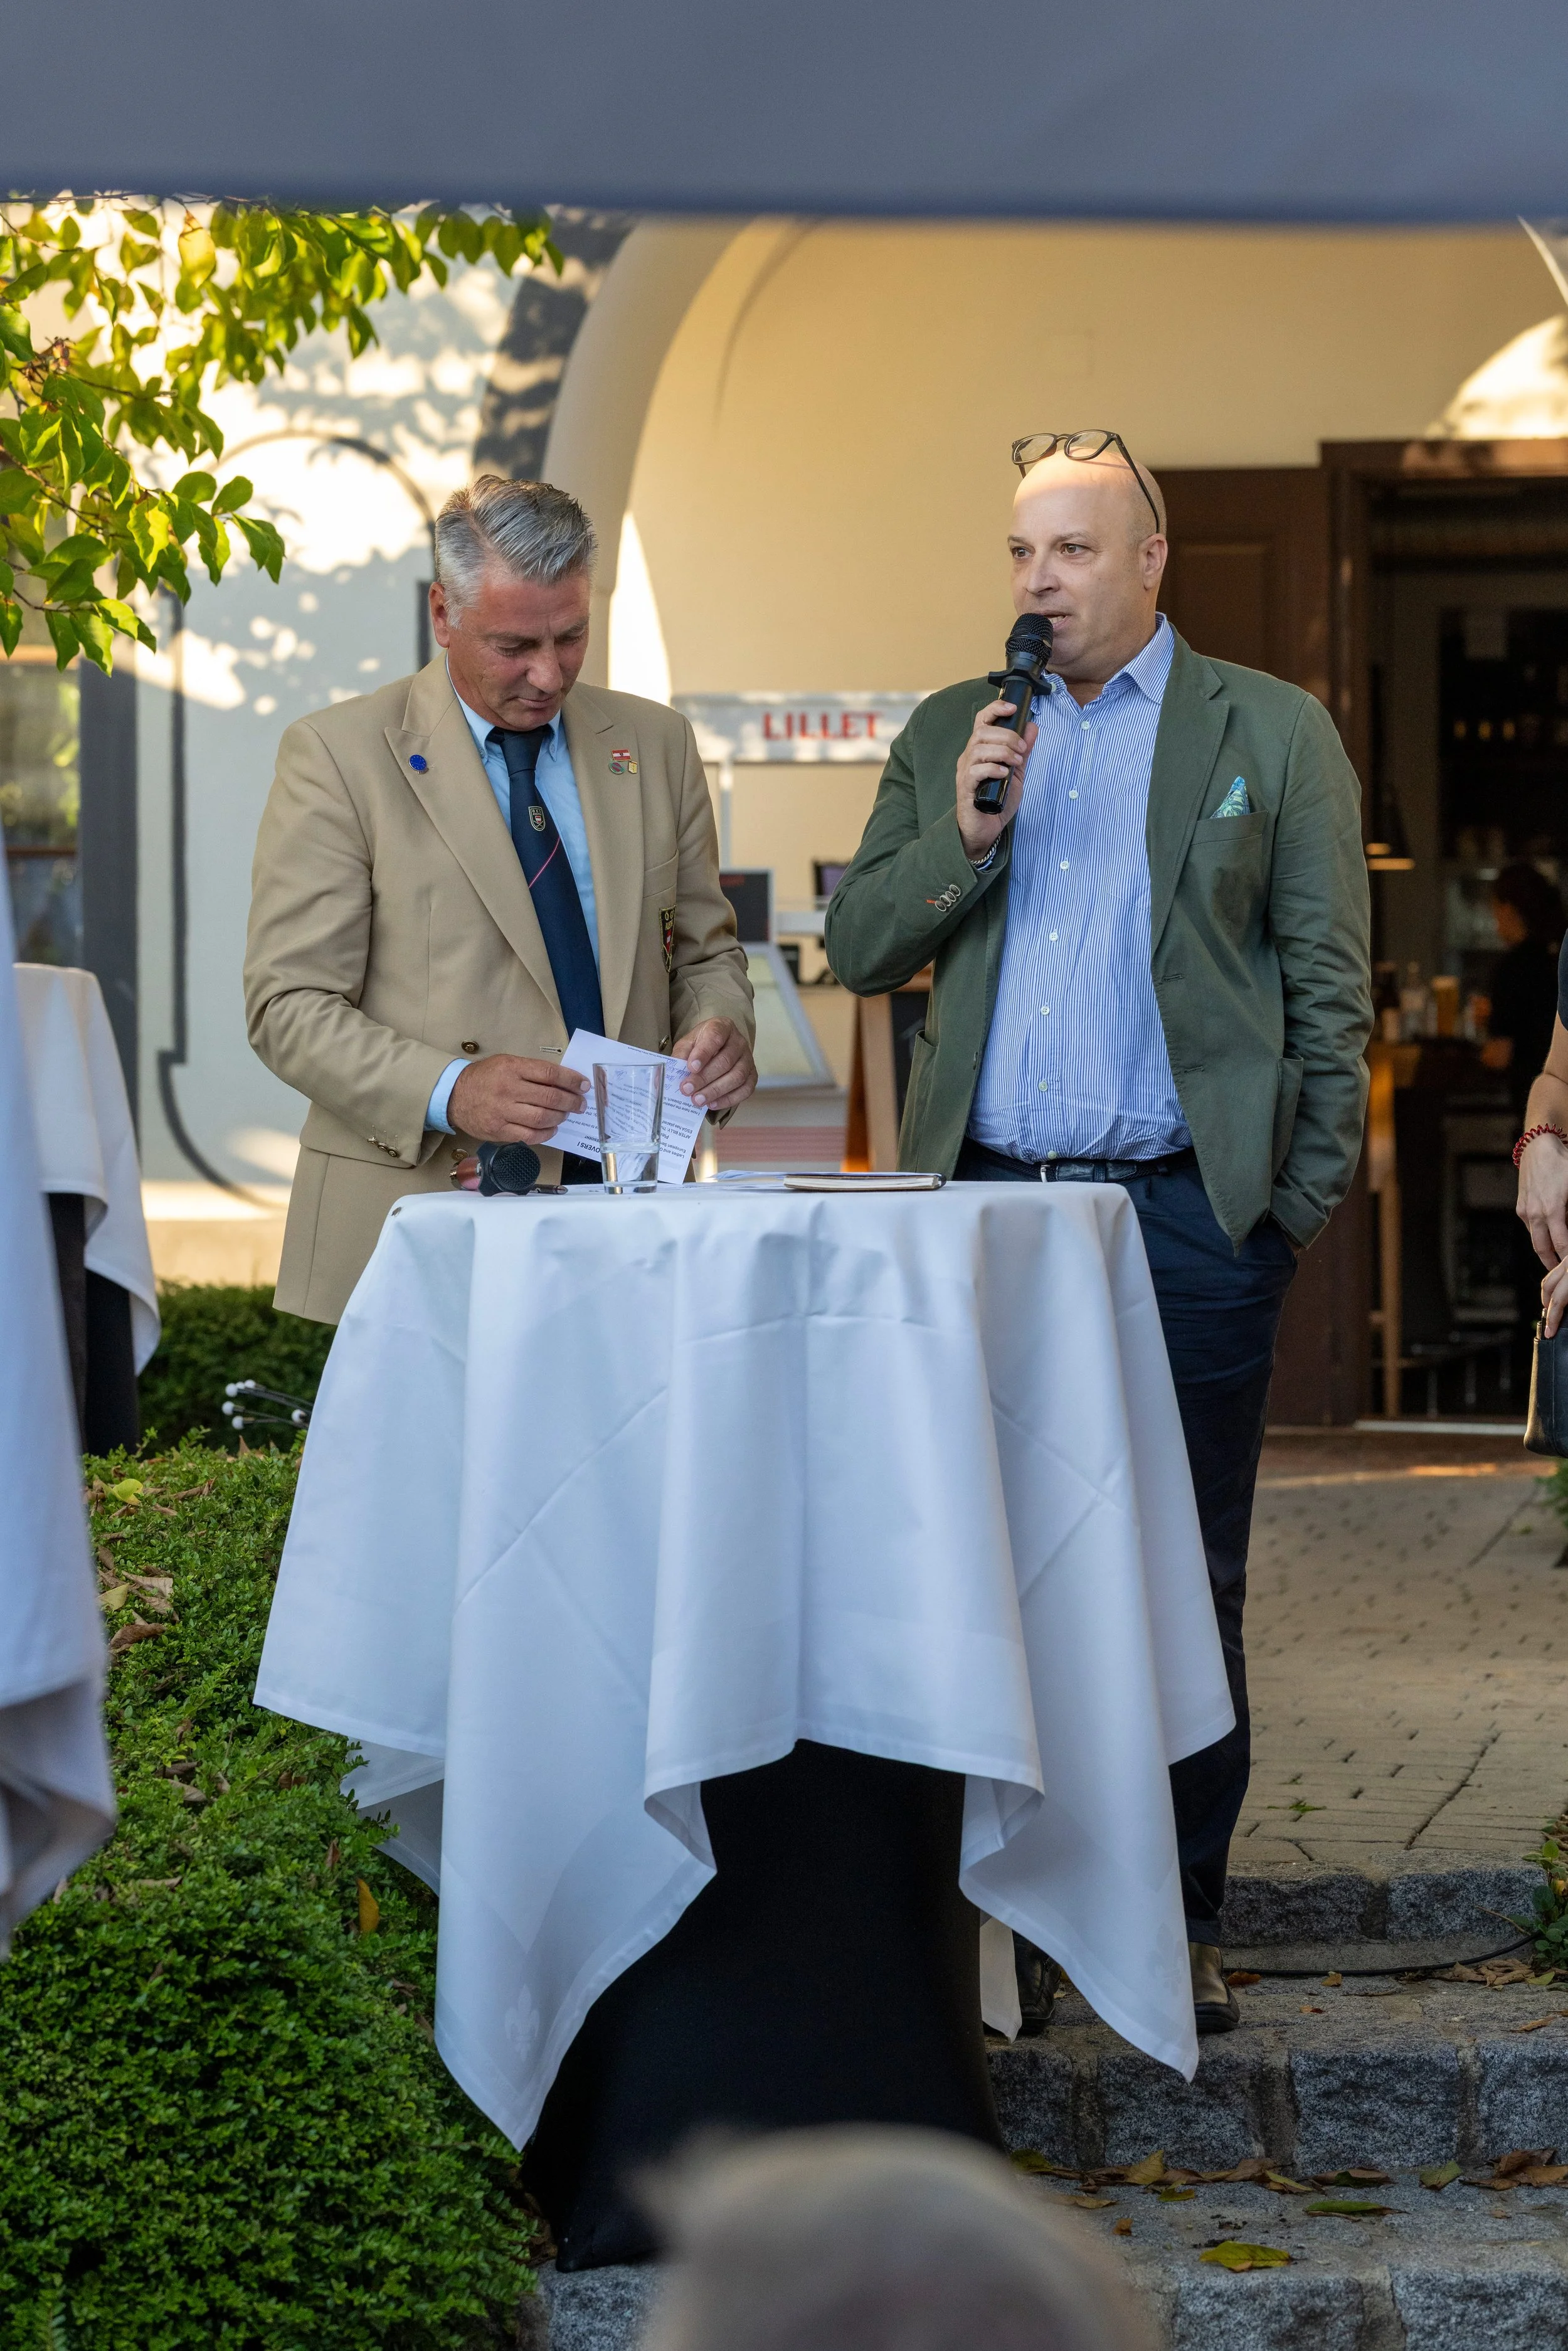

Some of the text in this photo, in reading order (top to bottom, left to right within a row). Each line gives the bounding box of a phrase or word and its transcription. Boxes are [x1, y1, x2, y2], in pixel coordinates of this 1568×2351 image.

[764, 712, 881, 740] LILLET
[661, 1119, 675, 1127] placed
[580, 1142, 601, 1153] OVERS
[667, 1144, 686, 1153] European
